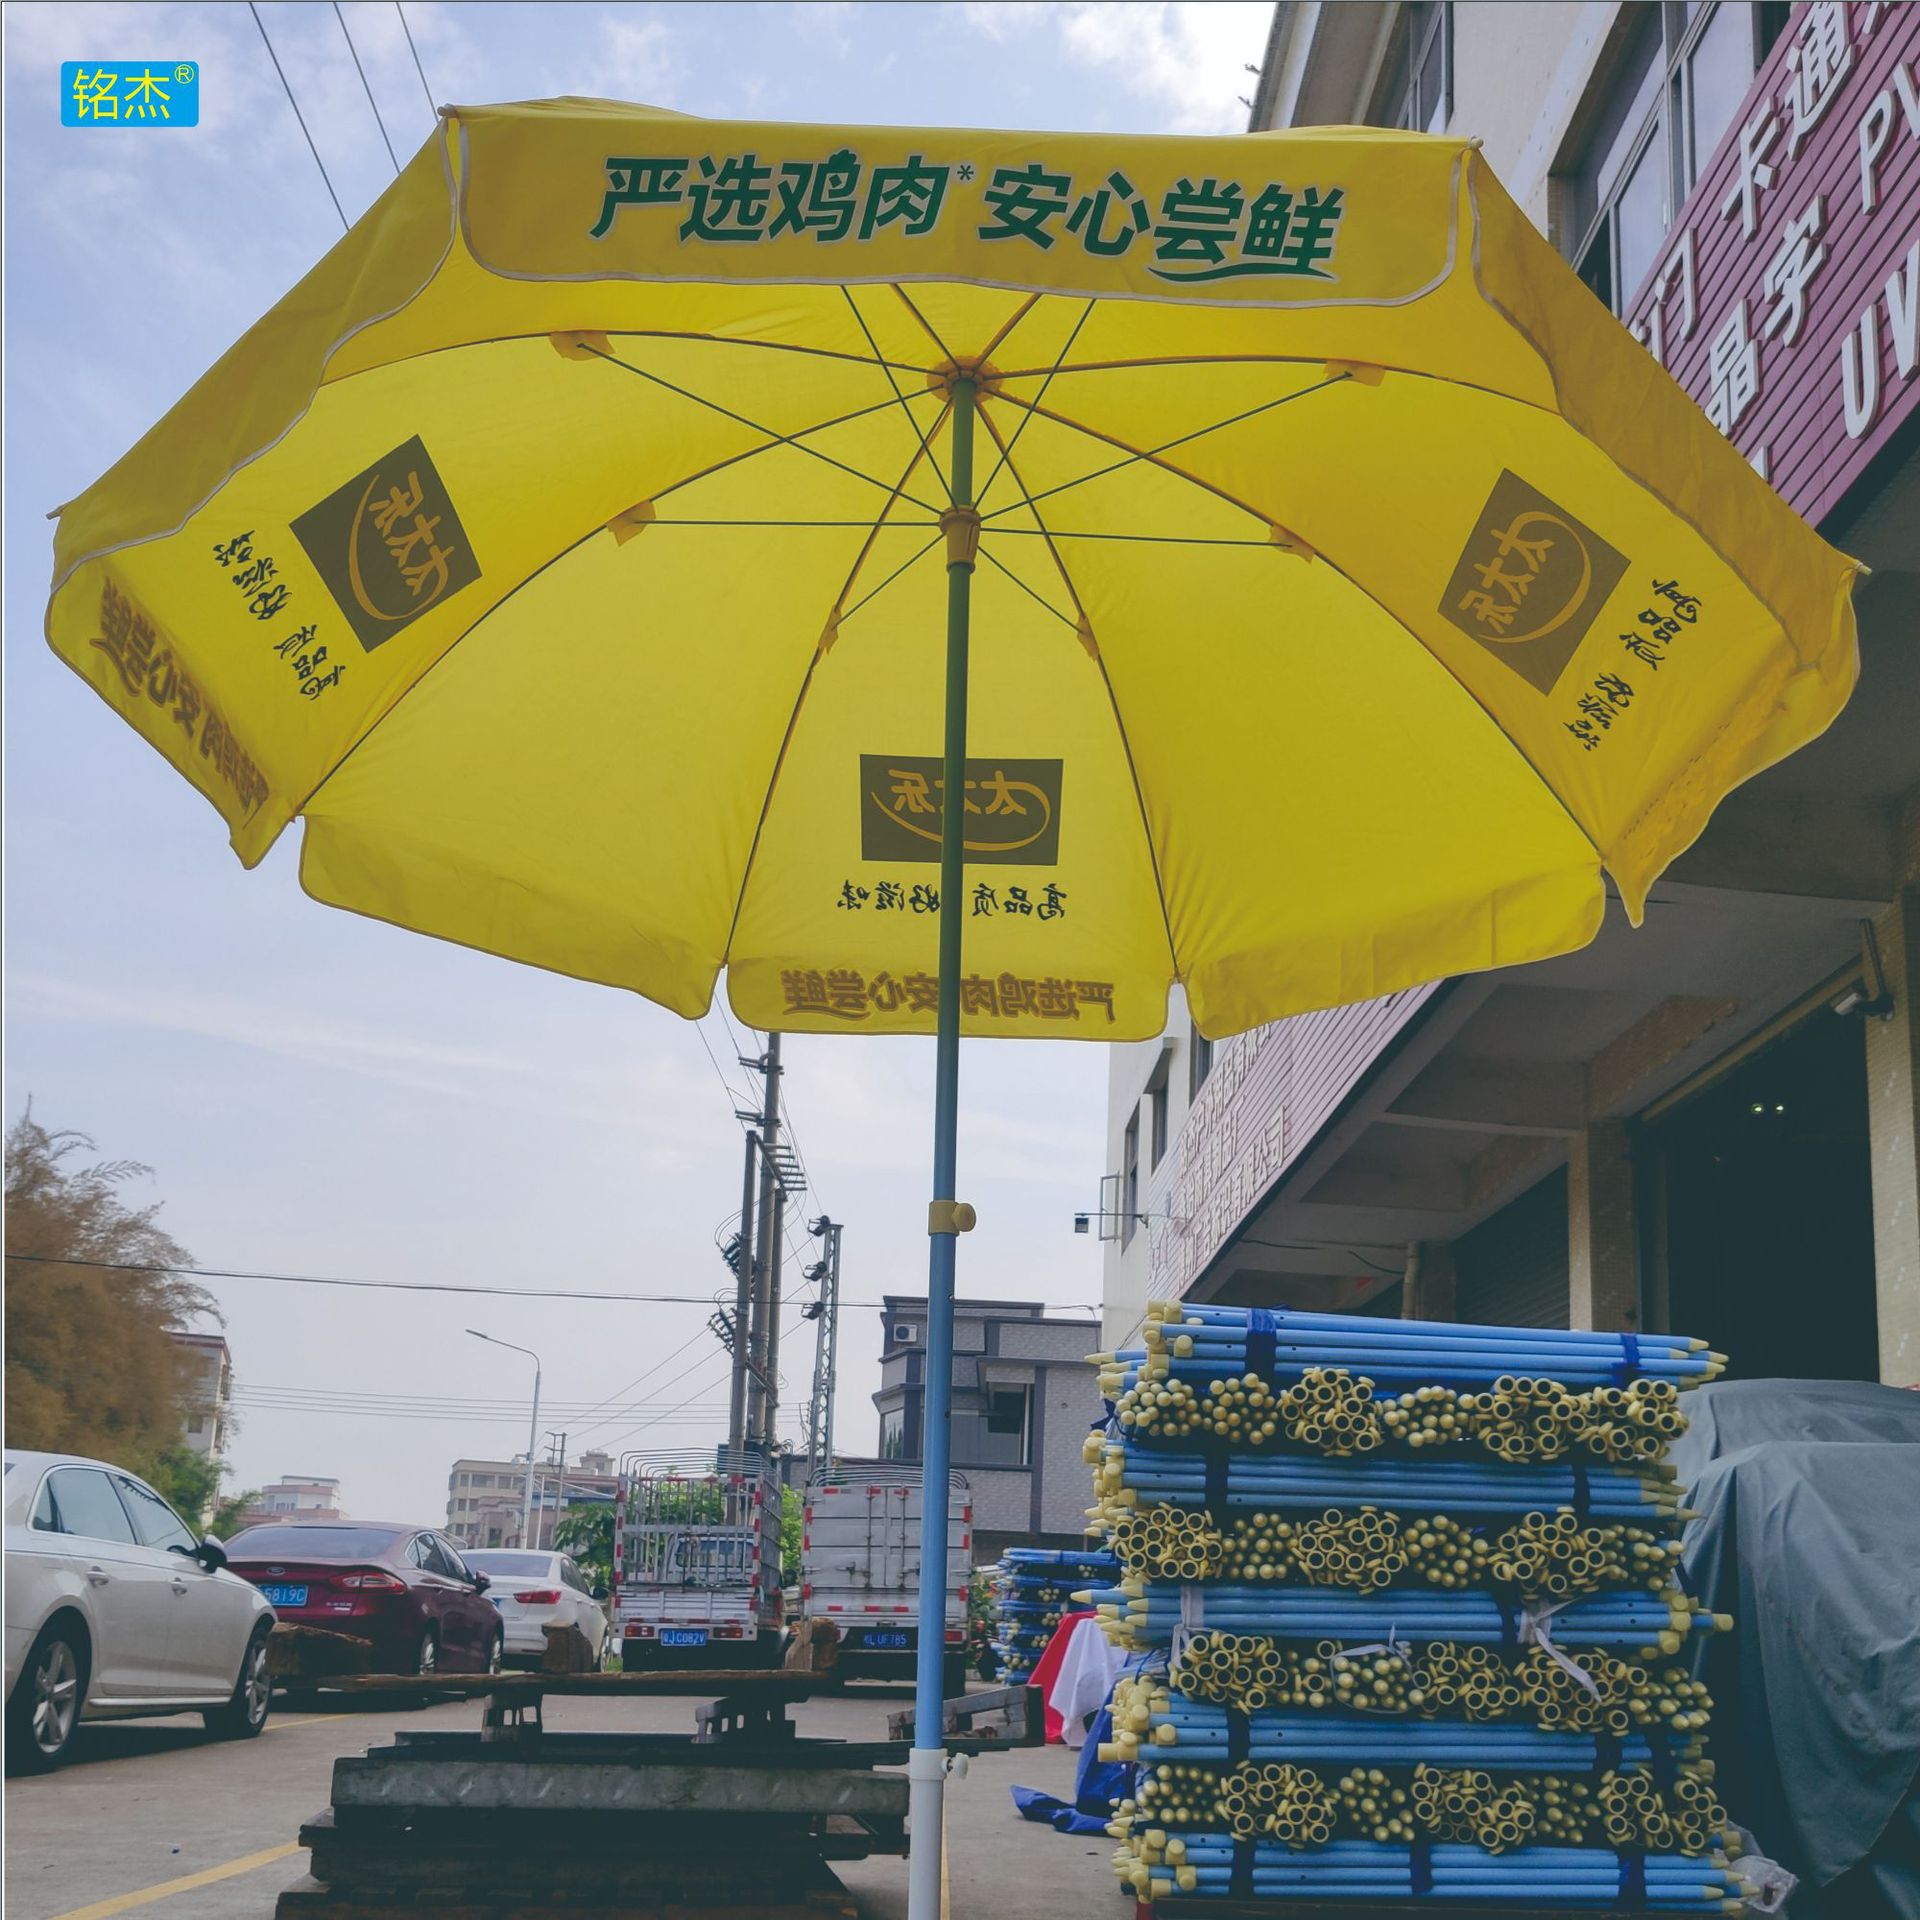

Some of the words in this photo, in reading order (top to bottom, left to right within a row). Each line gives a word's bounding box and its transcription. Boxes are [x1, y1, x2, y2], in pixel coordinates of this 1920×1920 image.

[1721, 2, 1888, 242] 卡通
[977, 162, 1344, 280] 安心尝鲜
